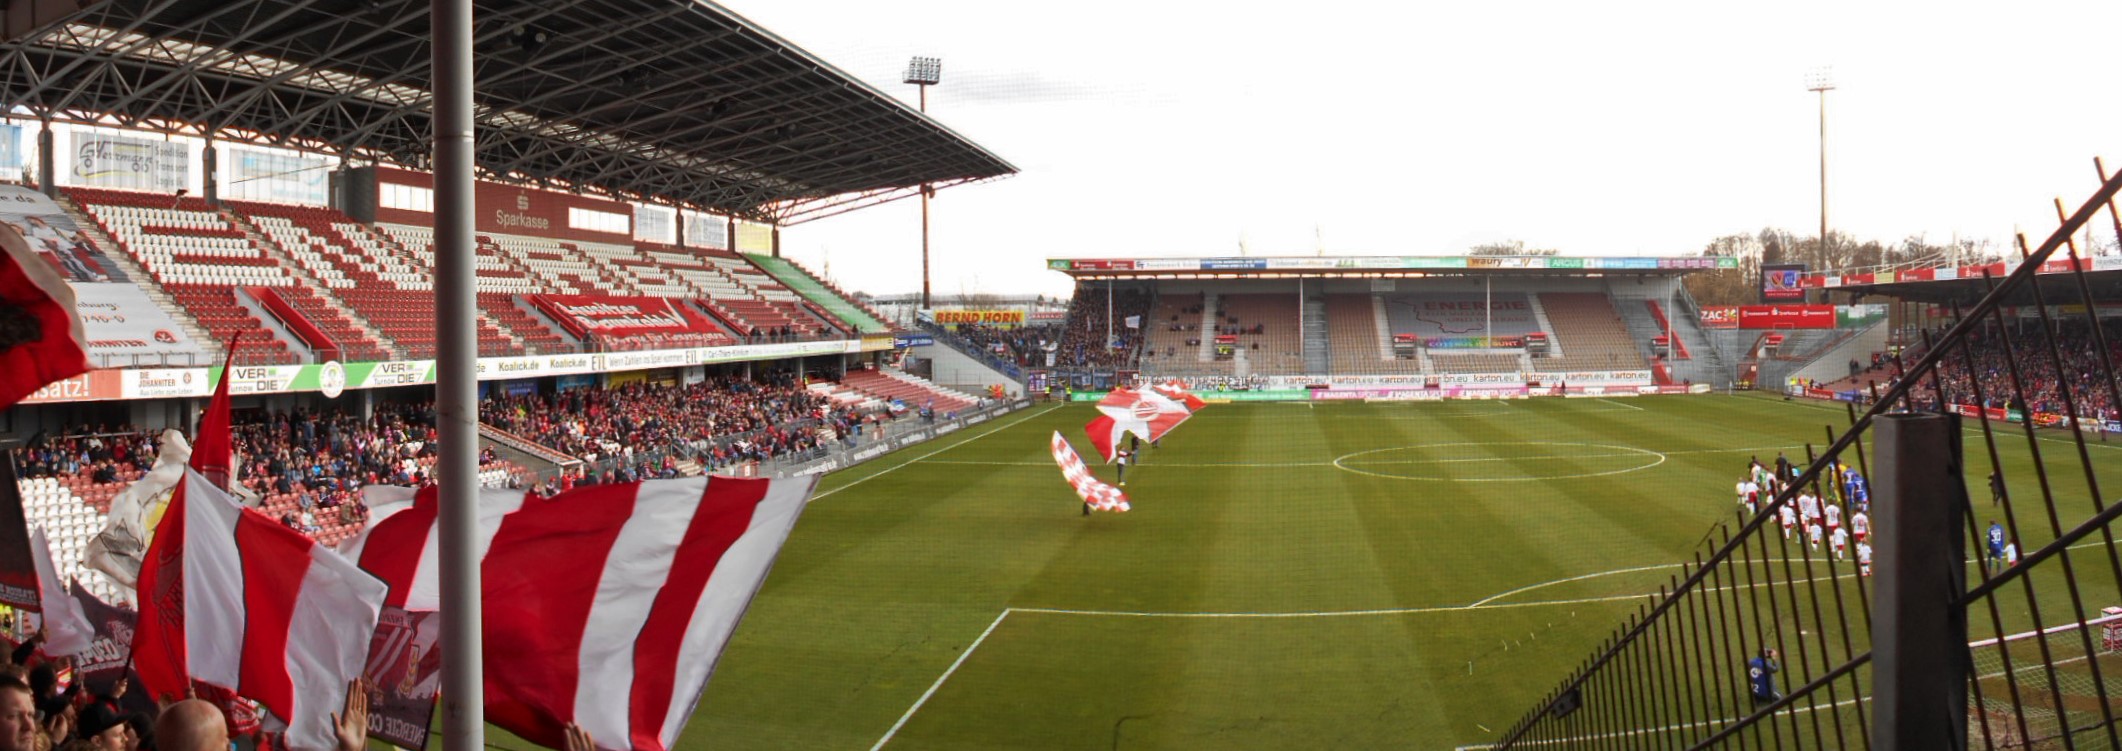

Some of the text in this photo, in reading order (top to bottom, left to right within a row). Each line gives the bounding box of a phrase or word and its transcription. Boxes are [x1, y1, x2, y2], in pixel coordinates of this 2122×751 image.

[496, 209, 549, 230] Sparkasse
[935, 311, 1022, 324] BERND HORN
[498, 361, 540, 373] Koalick.de
[550, 358, 587, 369] Koalick.de
[1331, 375, 1374, 384] karton.eu
[1379, 375, 1421, 384] karton.eu
[1425, 374, 1468, 384] karon.eu
[1473, 373, 1515, 383] karton.eu
[1565, 372, 1605, 381] karton.eu
[1610, 371, 1648, 380] karton.eu
[1990, 529, 2002, 542] 30
